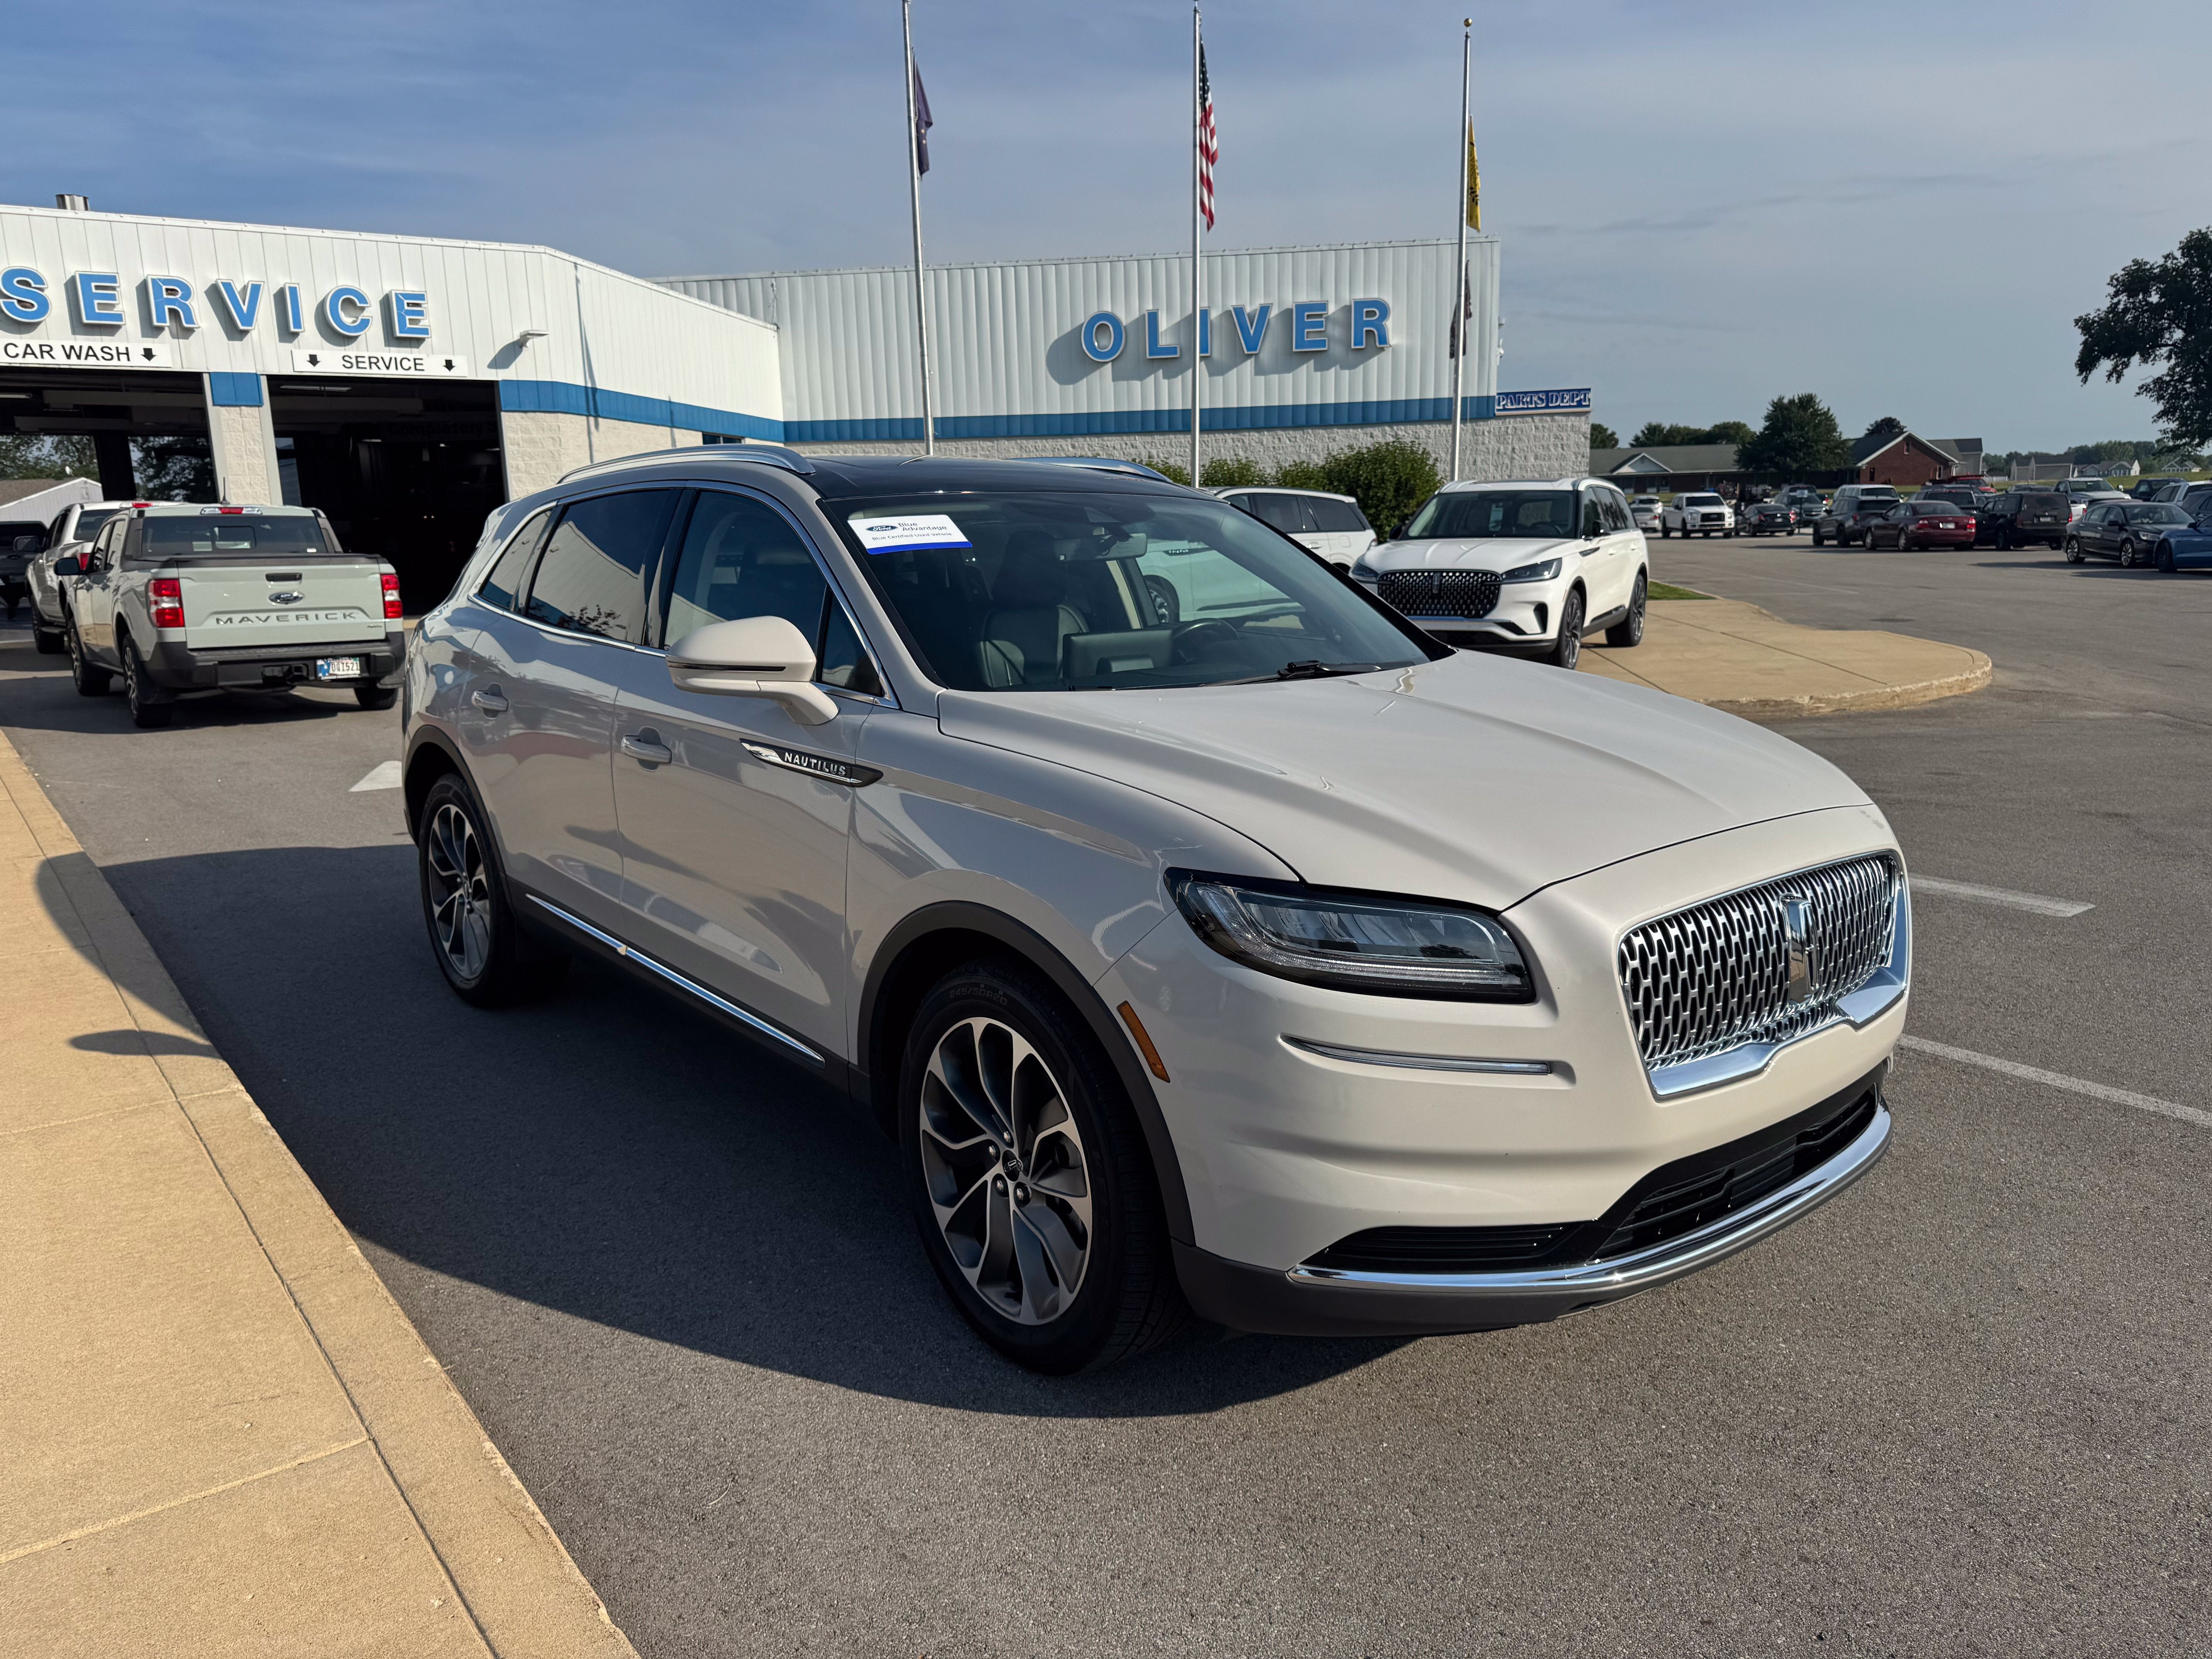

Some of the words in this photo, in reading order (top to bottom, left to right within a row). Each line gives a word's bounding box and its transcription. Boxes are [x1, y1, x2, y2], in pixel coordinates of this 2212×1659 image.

[0, 266, 432, 339] SERVICE
[1081, 298, 1391, 362] OLIVER
[4, 343, 55, 360] CAR
[61, 344, 131, 362] WASH
[342, 355, 425, 371] SERVICE
[1496, 393, 1546, 409] PARTS
[1549, 391, 1590, 407] DEPT
[216, 612, 356, 624] MAVERICK
[785, 752, 846, 776] NAUTILUS
[950, 987, 1008, 1006] 245/50R20
